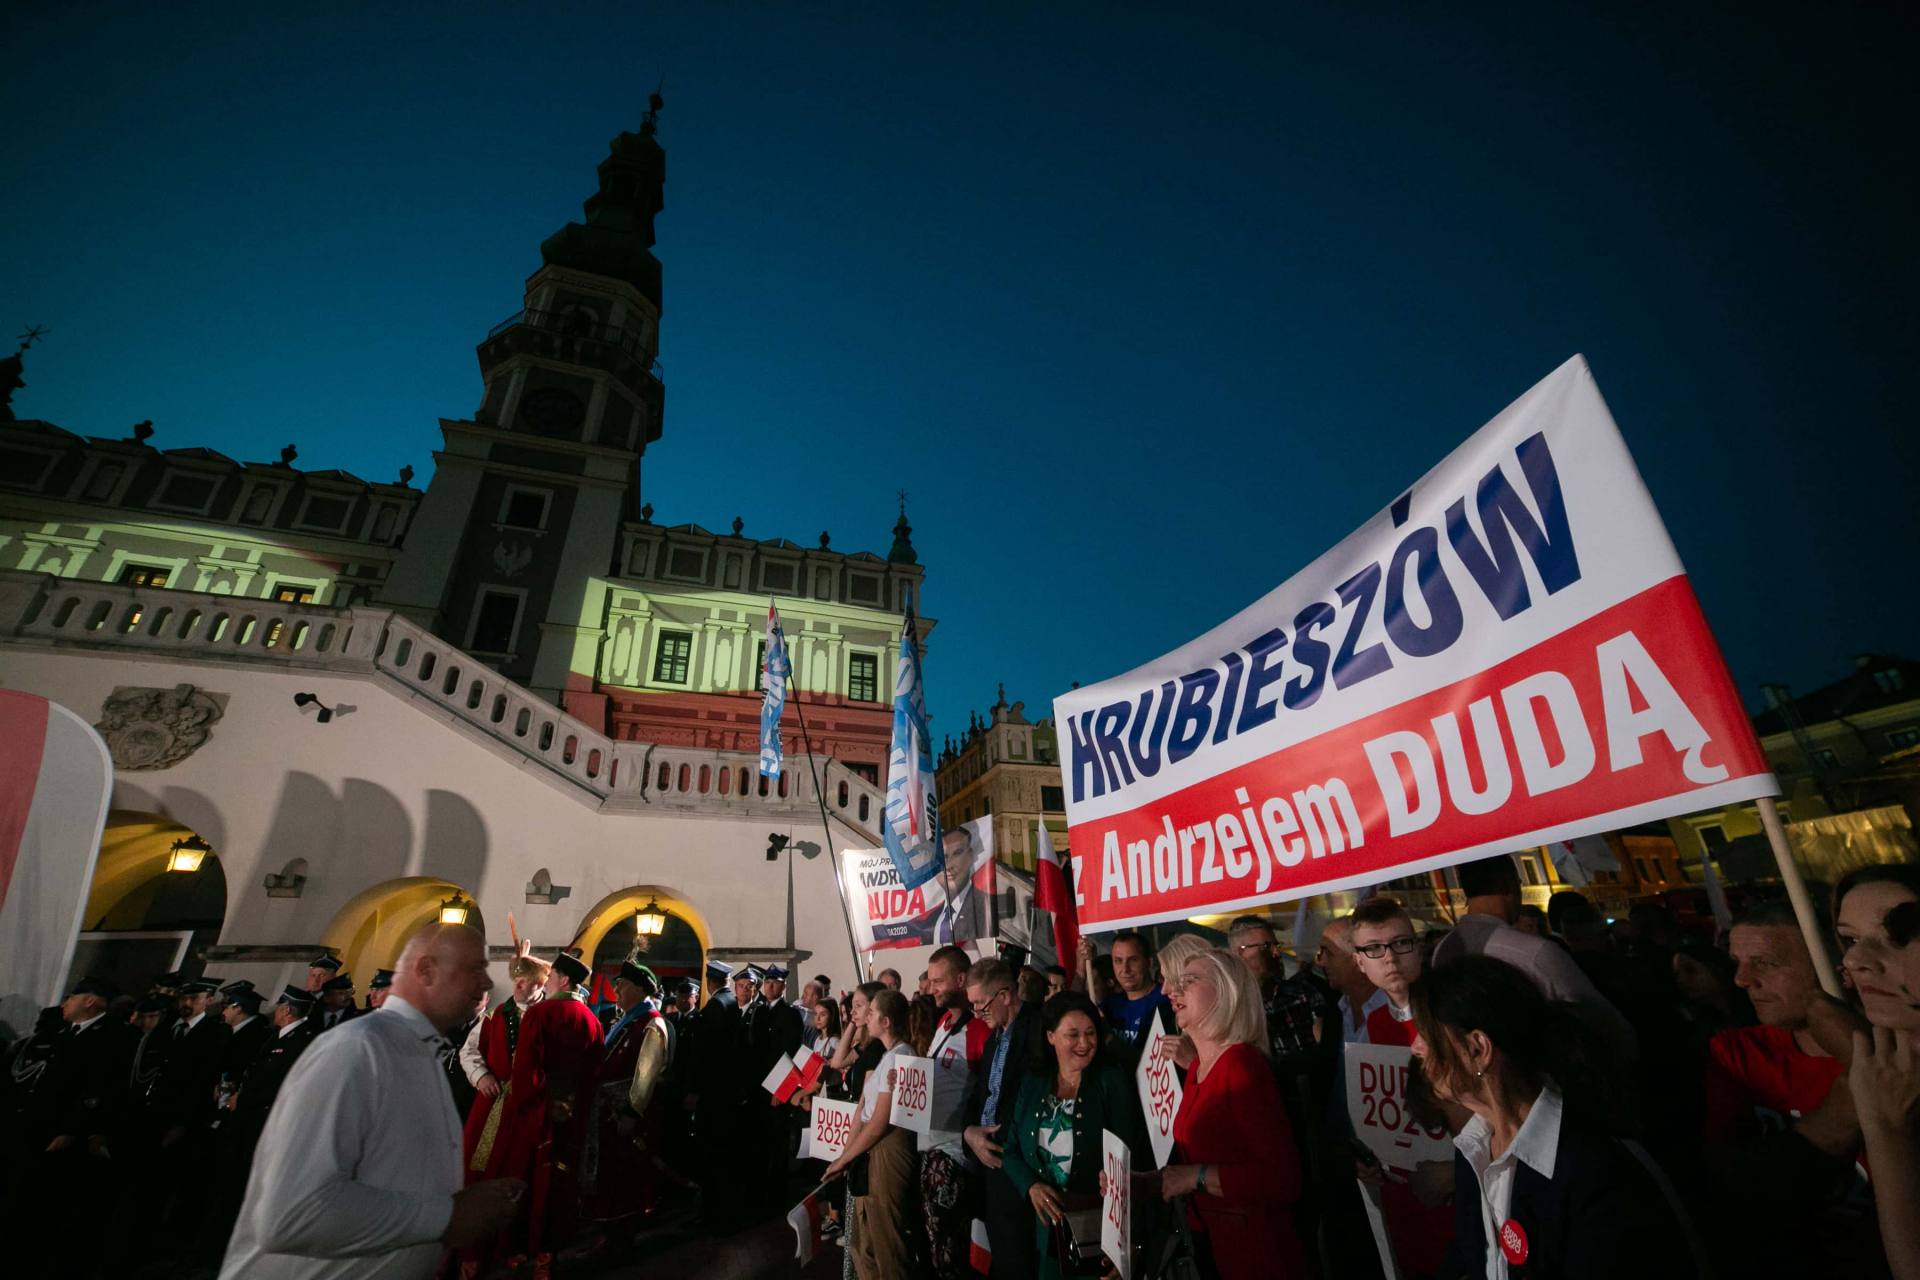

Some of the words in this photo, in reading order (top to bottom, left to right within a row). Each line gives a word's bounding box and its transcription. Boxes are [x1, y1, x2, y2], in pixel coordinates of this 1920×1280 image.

[1067, 431, 1582, 803] HRUBIESZÓW
[1101, 777, 1365, 903] Andrzejem
[1363, 630, 1730, 838] DUDĄ
[898, 1066, 927, 1091] DUDA
[898, 1086, 927, 1111] 2020
[817, 1108, 851, 1130] DUDA
